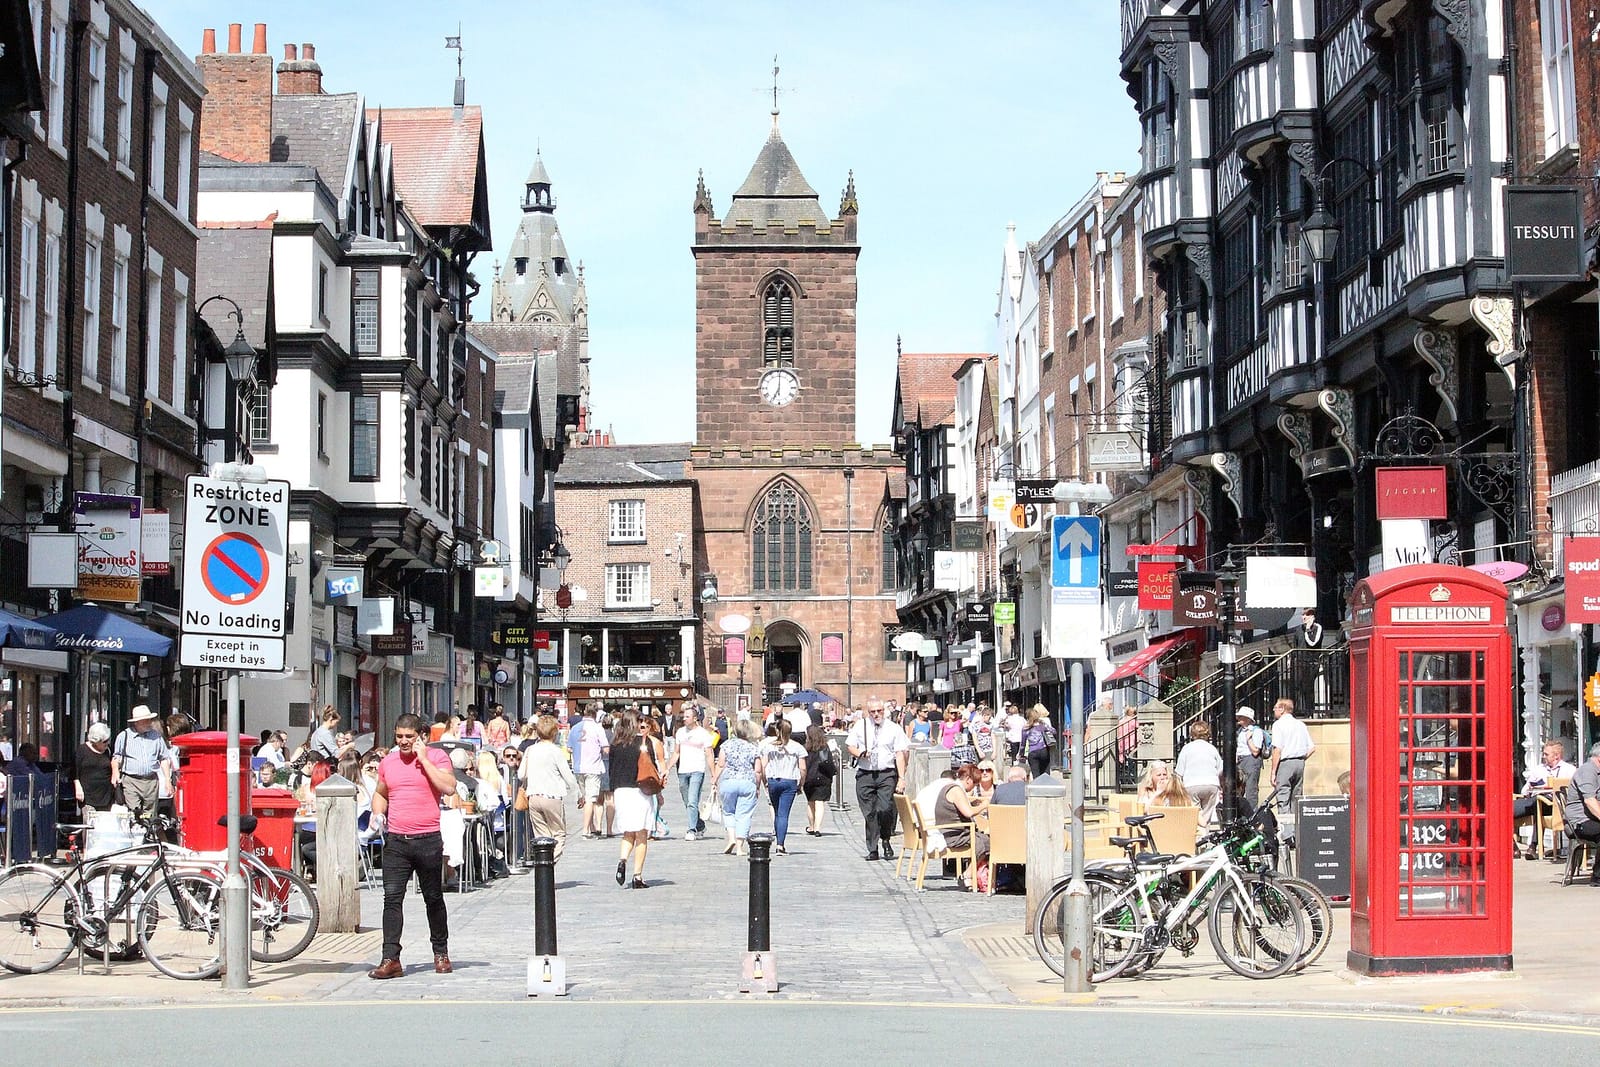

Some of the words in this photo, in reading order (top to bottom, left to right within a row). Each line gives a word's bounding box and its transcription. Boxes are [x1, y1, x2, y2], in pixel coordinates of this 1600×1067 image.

[1513, 225, 1575, 239] TESSUTI
[1102, 439, 1129, 455] AR
[193, 483, 282, 503] Restricted
[1386, 488, 1437, 496] JIGSAW
[205, 505, 269, 526] ZONE
[1568, 559, 1599, 574] spud
[1148, 574, 1174, 583] CAFE
[1143, 585, 1173, 594] ROUG
[1396, 607, 1486, 620] TELEPHONE
[186, 610, 210, 626] No
[219, 612, 281, 632] loading
[507, 627, 526, 635] CITY
[207, 639, 244, 651] Except
[249, 641, 259, 651] in
[199, 652, 235, 664] signed
[240, 654, 266, 666] bays
[589, 688, 606, 697] OLD
[608, 688, 629, 698] GUYS
[629, 687, 651, 697] RULE
[1406, 823, 1446, 845] ape
